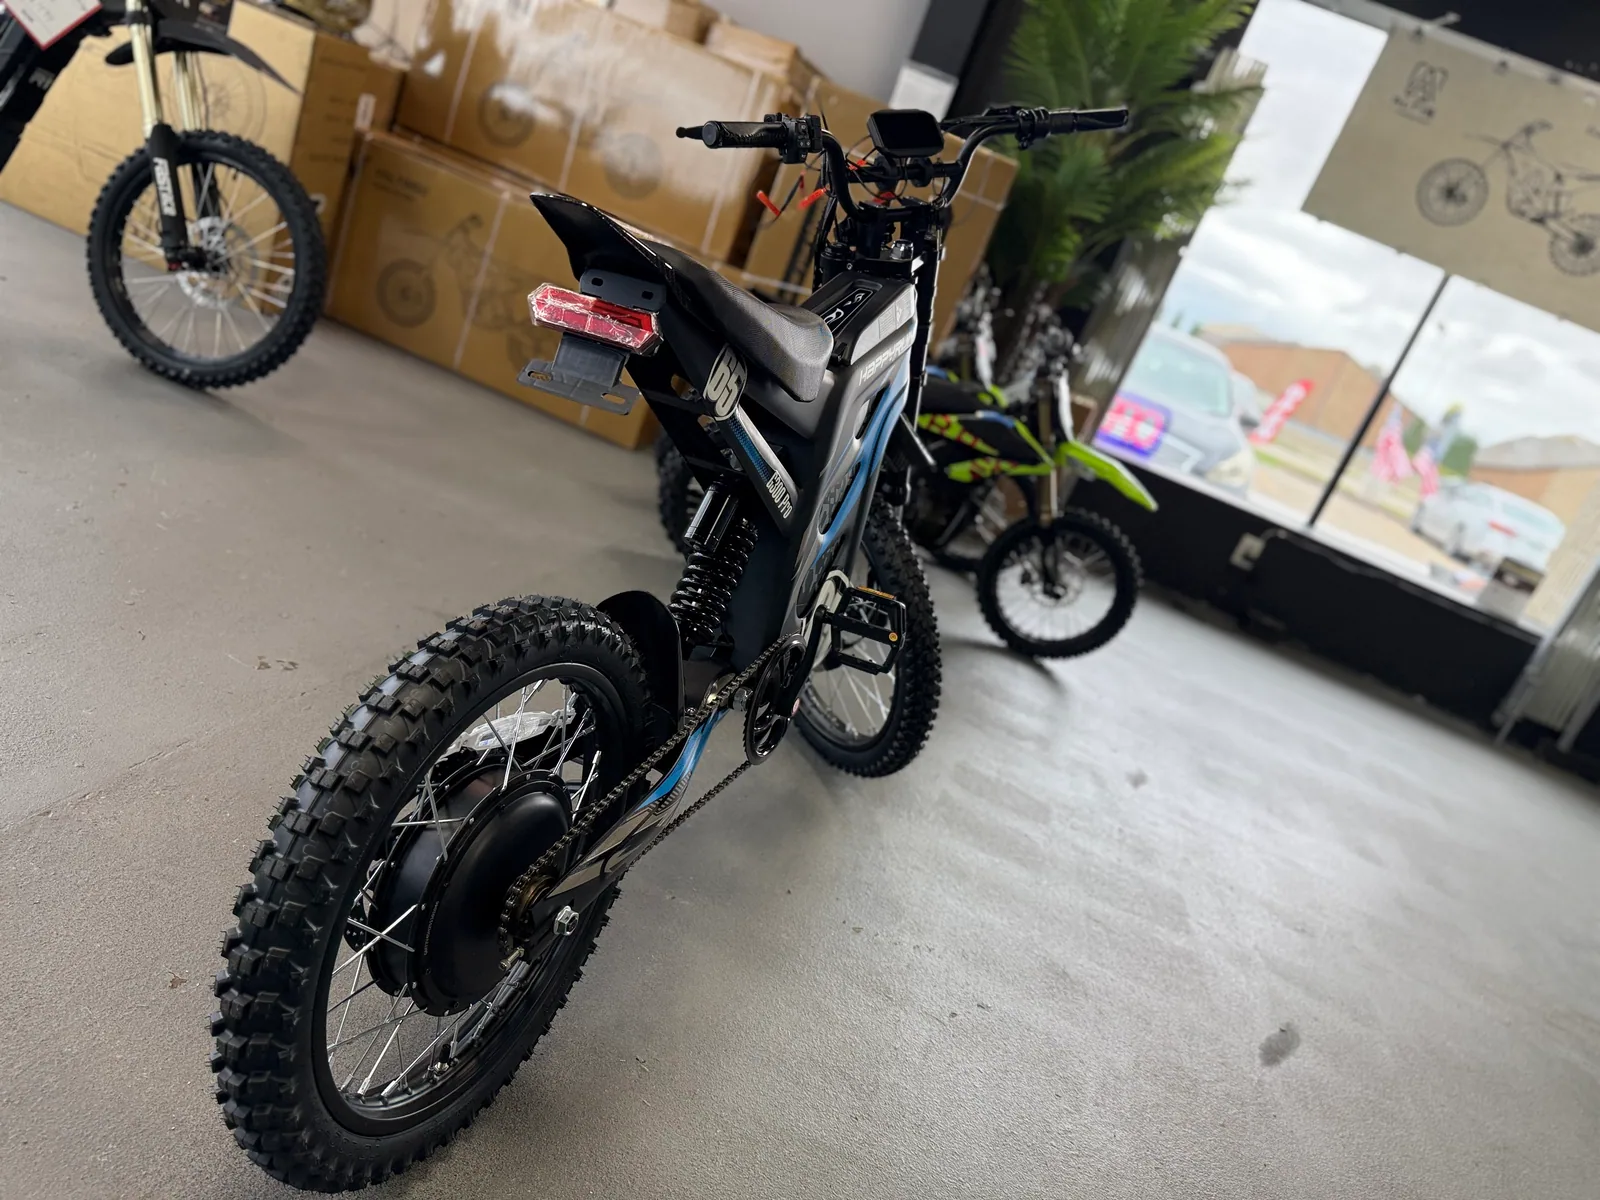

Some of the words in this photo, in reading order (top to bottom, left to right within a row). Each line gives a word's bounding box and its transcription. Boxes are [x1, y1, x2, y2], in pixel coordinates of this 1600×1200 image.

[707, 346, 747, 417] 65
[765, 470, 787, 504] G300
[777, 493, 793, 519] Pro
